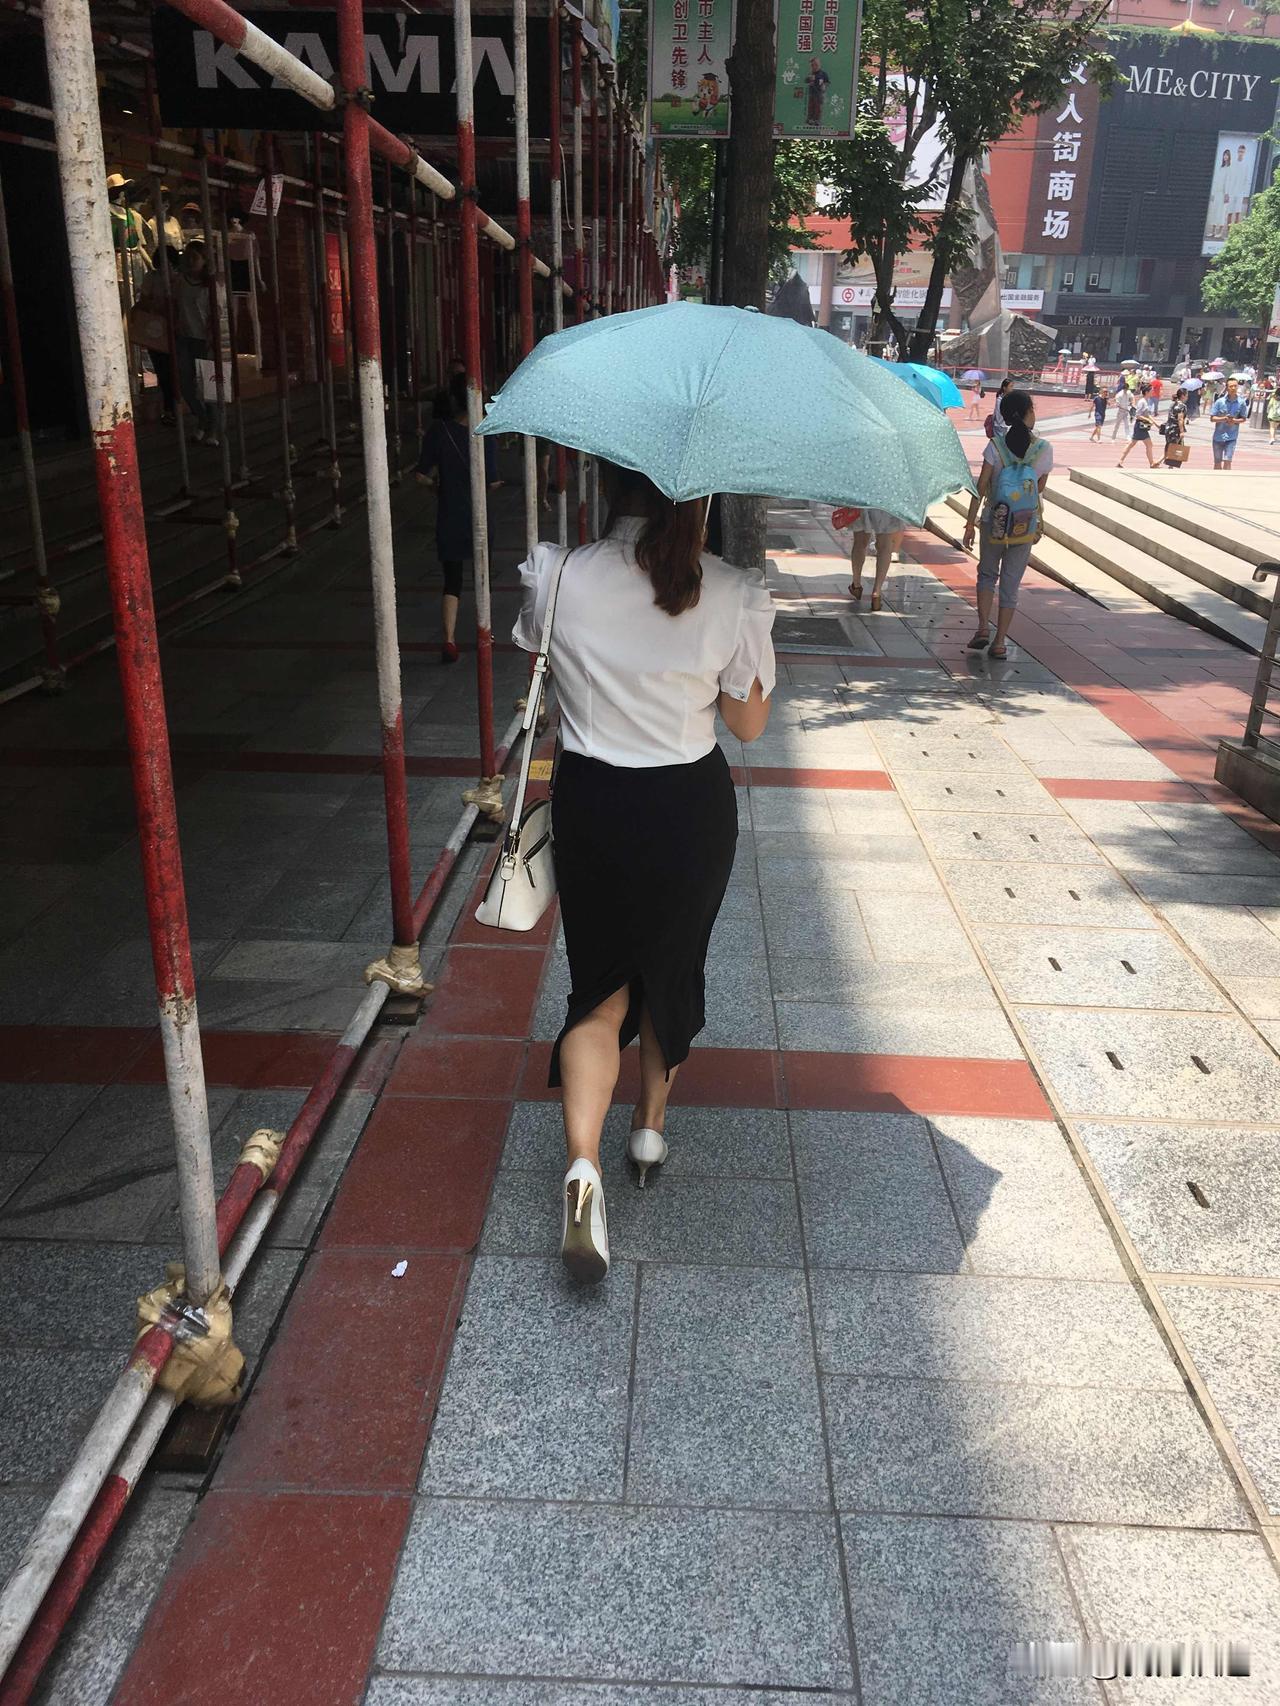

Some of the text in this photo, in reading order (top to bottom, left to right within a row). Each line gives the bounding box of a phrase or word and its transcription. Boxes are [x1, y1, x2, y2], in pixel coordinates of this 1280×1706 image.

[671, 0, 688, 88] 创卫先锋
[797, 0, 813, 52] 中国强
[822, 0, 839, 52] 中国兴
[1125, 65, 1262, 102] ME&CITY
